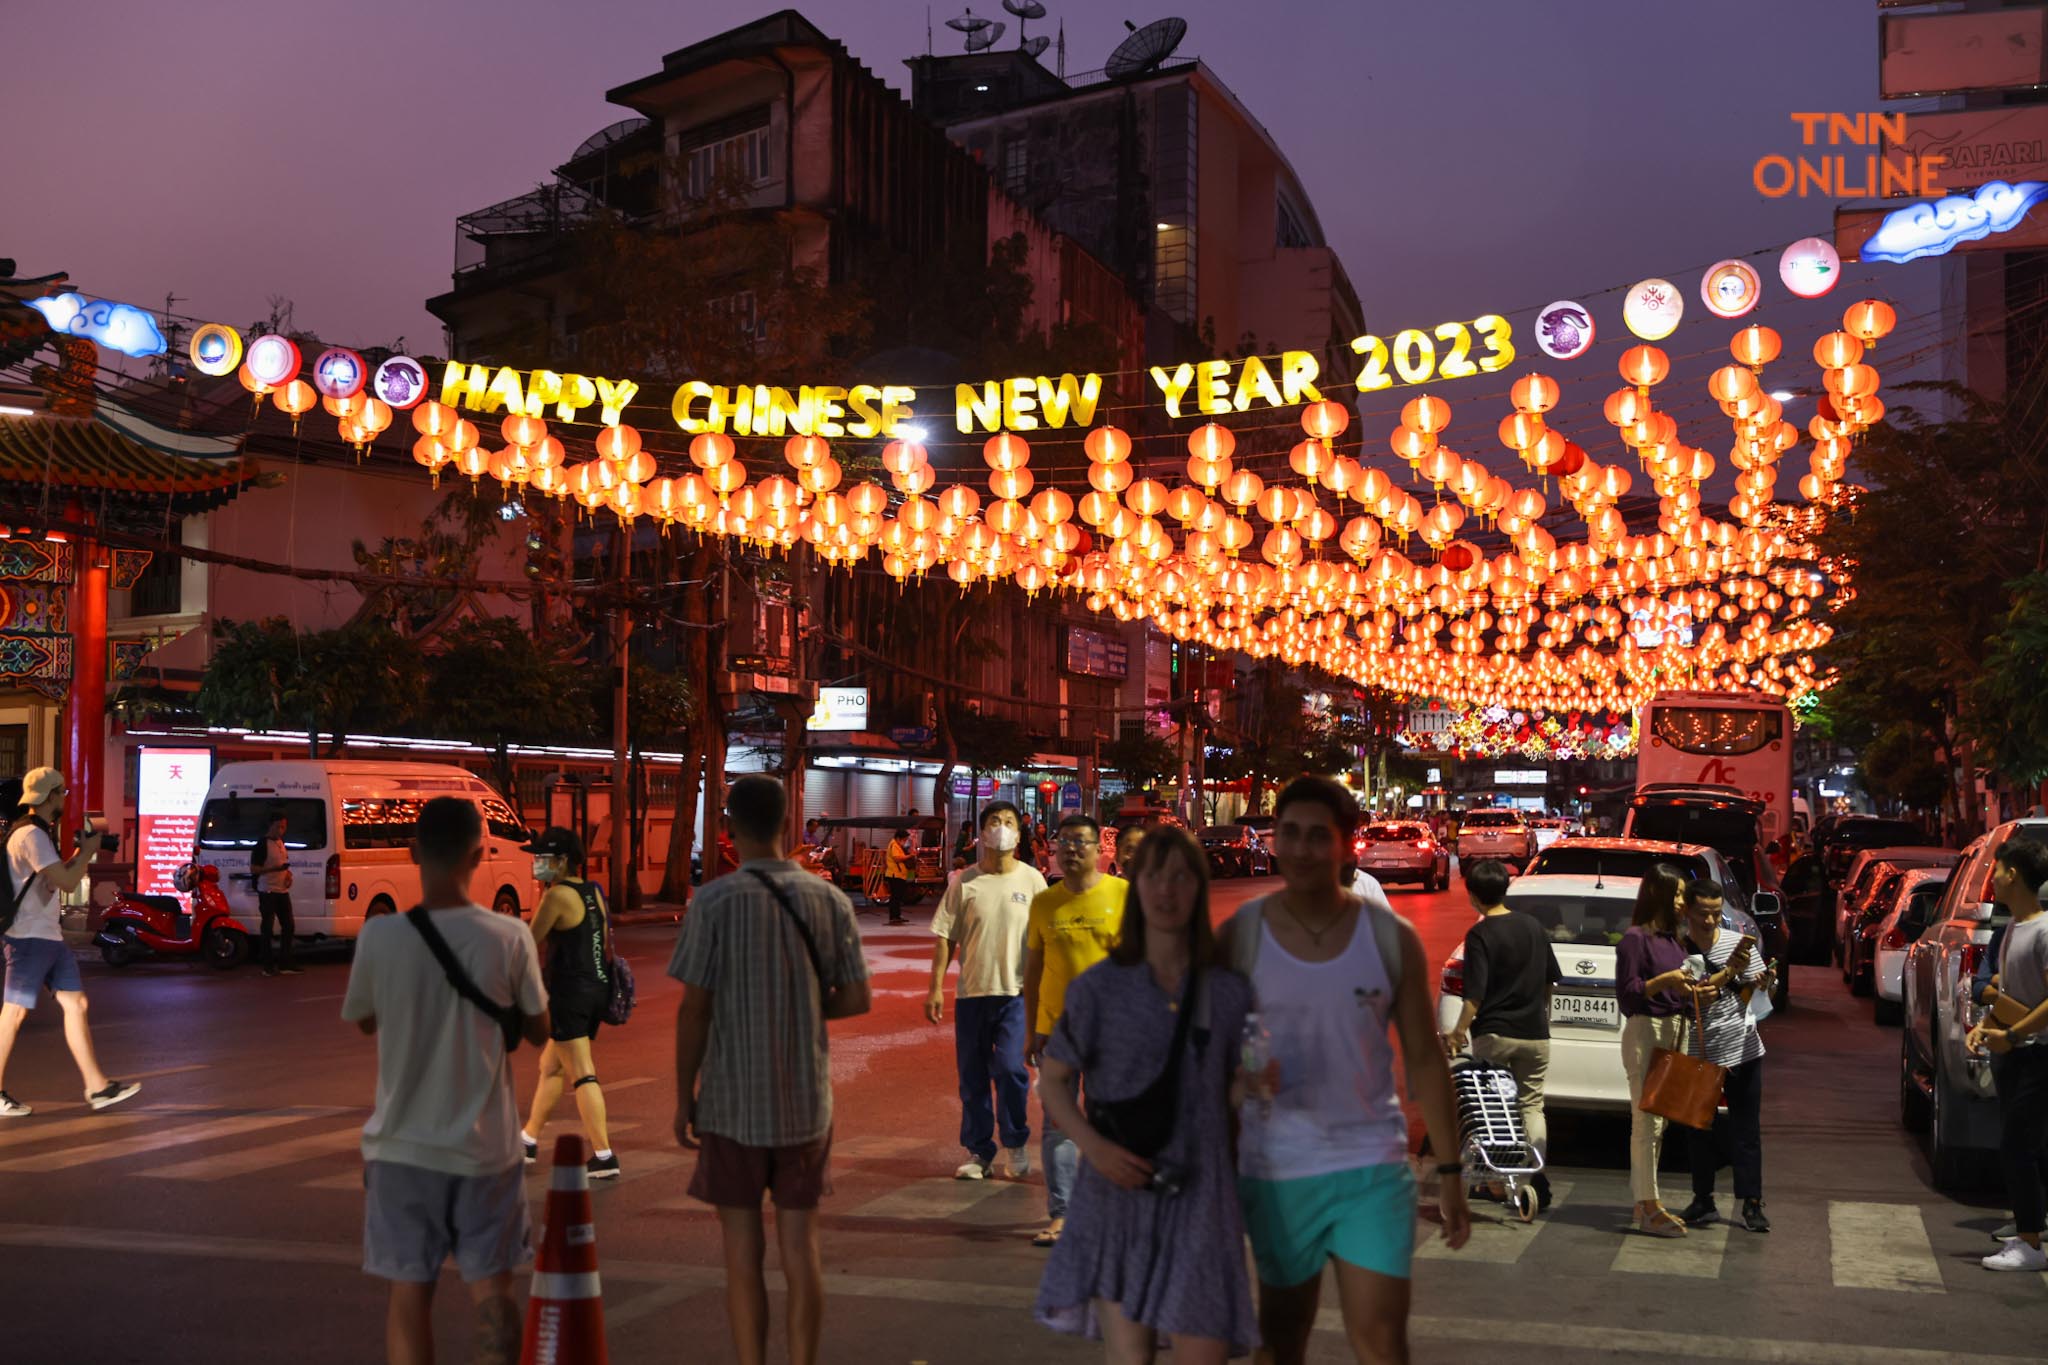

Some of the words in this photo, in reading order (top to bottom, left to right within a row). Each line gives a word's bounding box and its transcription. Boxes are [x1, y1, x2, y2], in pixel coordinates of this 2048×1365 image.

[1937, 140, 2043, 169] SAFARI
[440, 360, 639, 428] HAPPY
[671, 380, 918, 439] CHINESE
[955, 373, 1103, 434] NEW
[1150, 350, 1322, 419] YEAR
[1351, 314, 1515, 392] 2023
[837, 695, 865, 706] PHO
[169, 764, 183, 780] 天
[1584, 999, 1615, 1014] 8441
